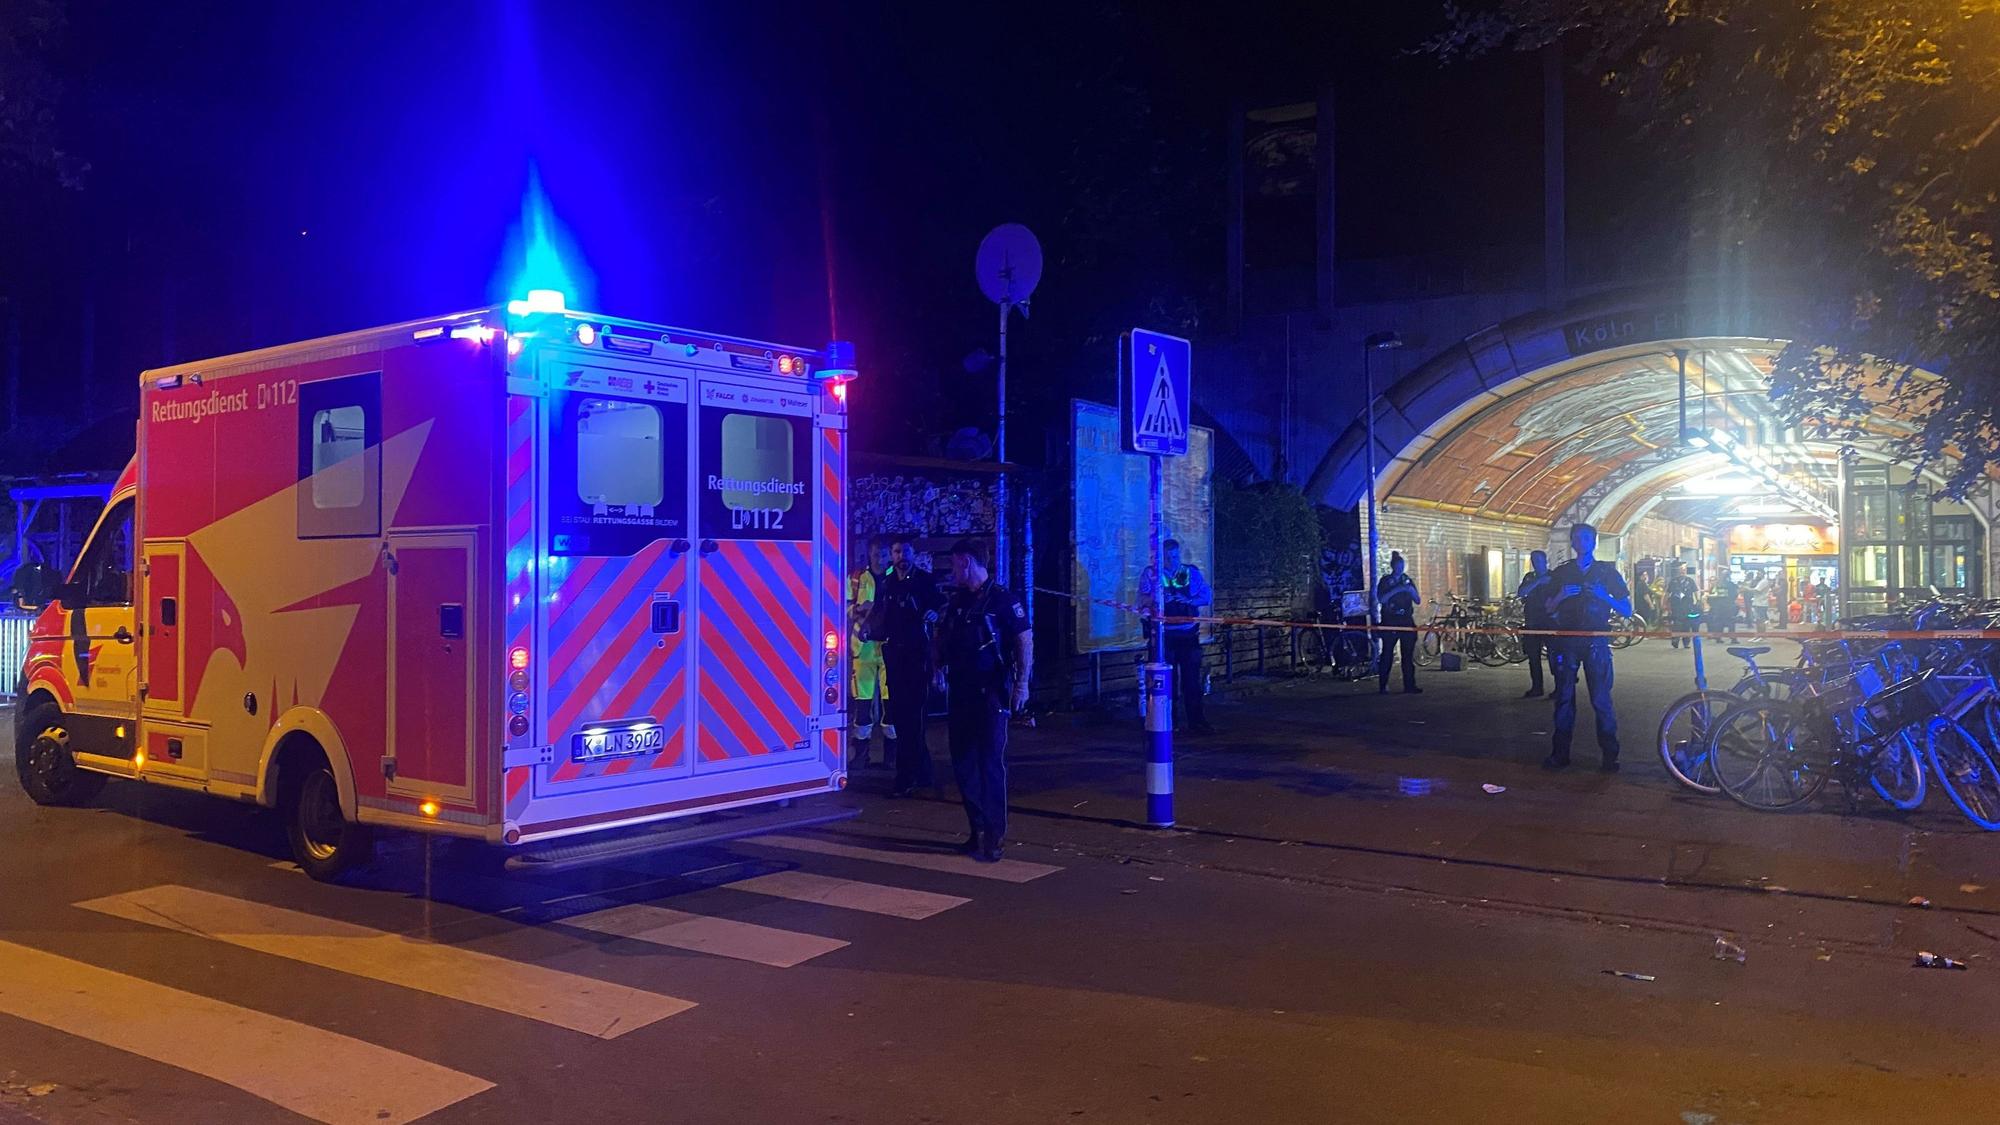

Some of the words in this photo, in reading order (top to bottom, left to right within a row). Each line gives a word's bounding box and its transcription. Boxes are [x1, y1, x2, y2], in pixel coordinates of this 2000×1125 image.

[1574, 320, 1635, 348] Köln
[152, 390, 249, 424] Rettungsdienst
[271, 379, 297, 406] 112
[708, 474, 805, 496] Rettungsdienst
[593, 517, 654, 526] RETTUNGSGASSE
[751, 507, 784, 529] 112
[583, 739, 593, 755] K
[626, 731, 661, 750] 3902
